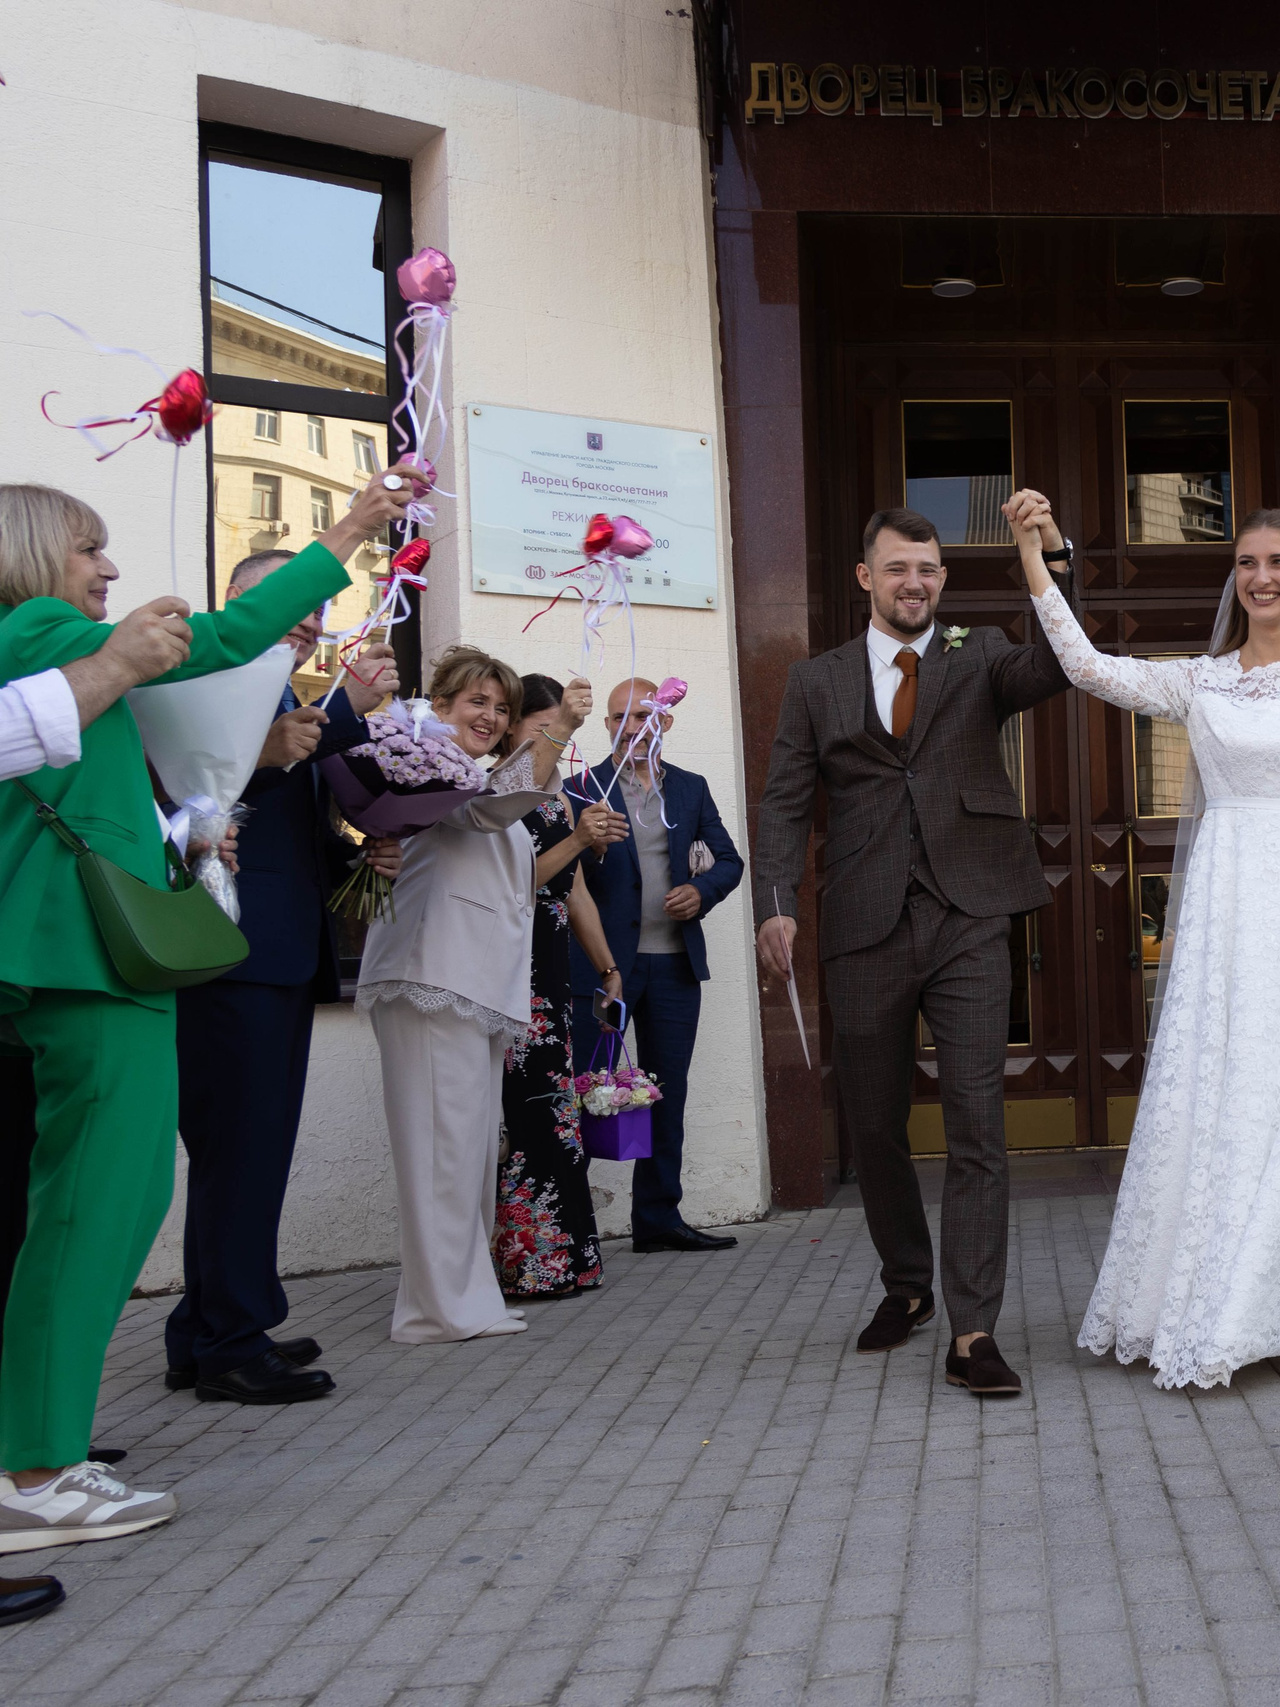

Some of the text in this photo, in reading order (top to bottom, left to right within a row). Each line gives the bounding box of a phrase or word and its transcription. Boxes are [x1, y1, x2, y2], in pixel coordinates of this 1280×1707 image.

[745, 62, 942, 126] ДВОРЕЦ
[521, 471, 569, 489] Дворец
[572, 477, 669, 498] бракосочетания
[523, 545, 558, 554] ВОСКРЕСЕНЬЕ
